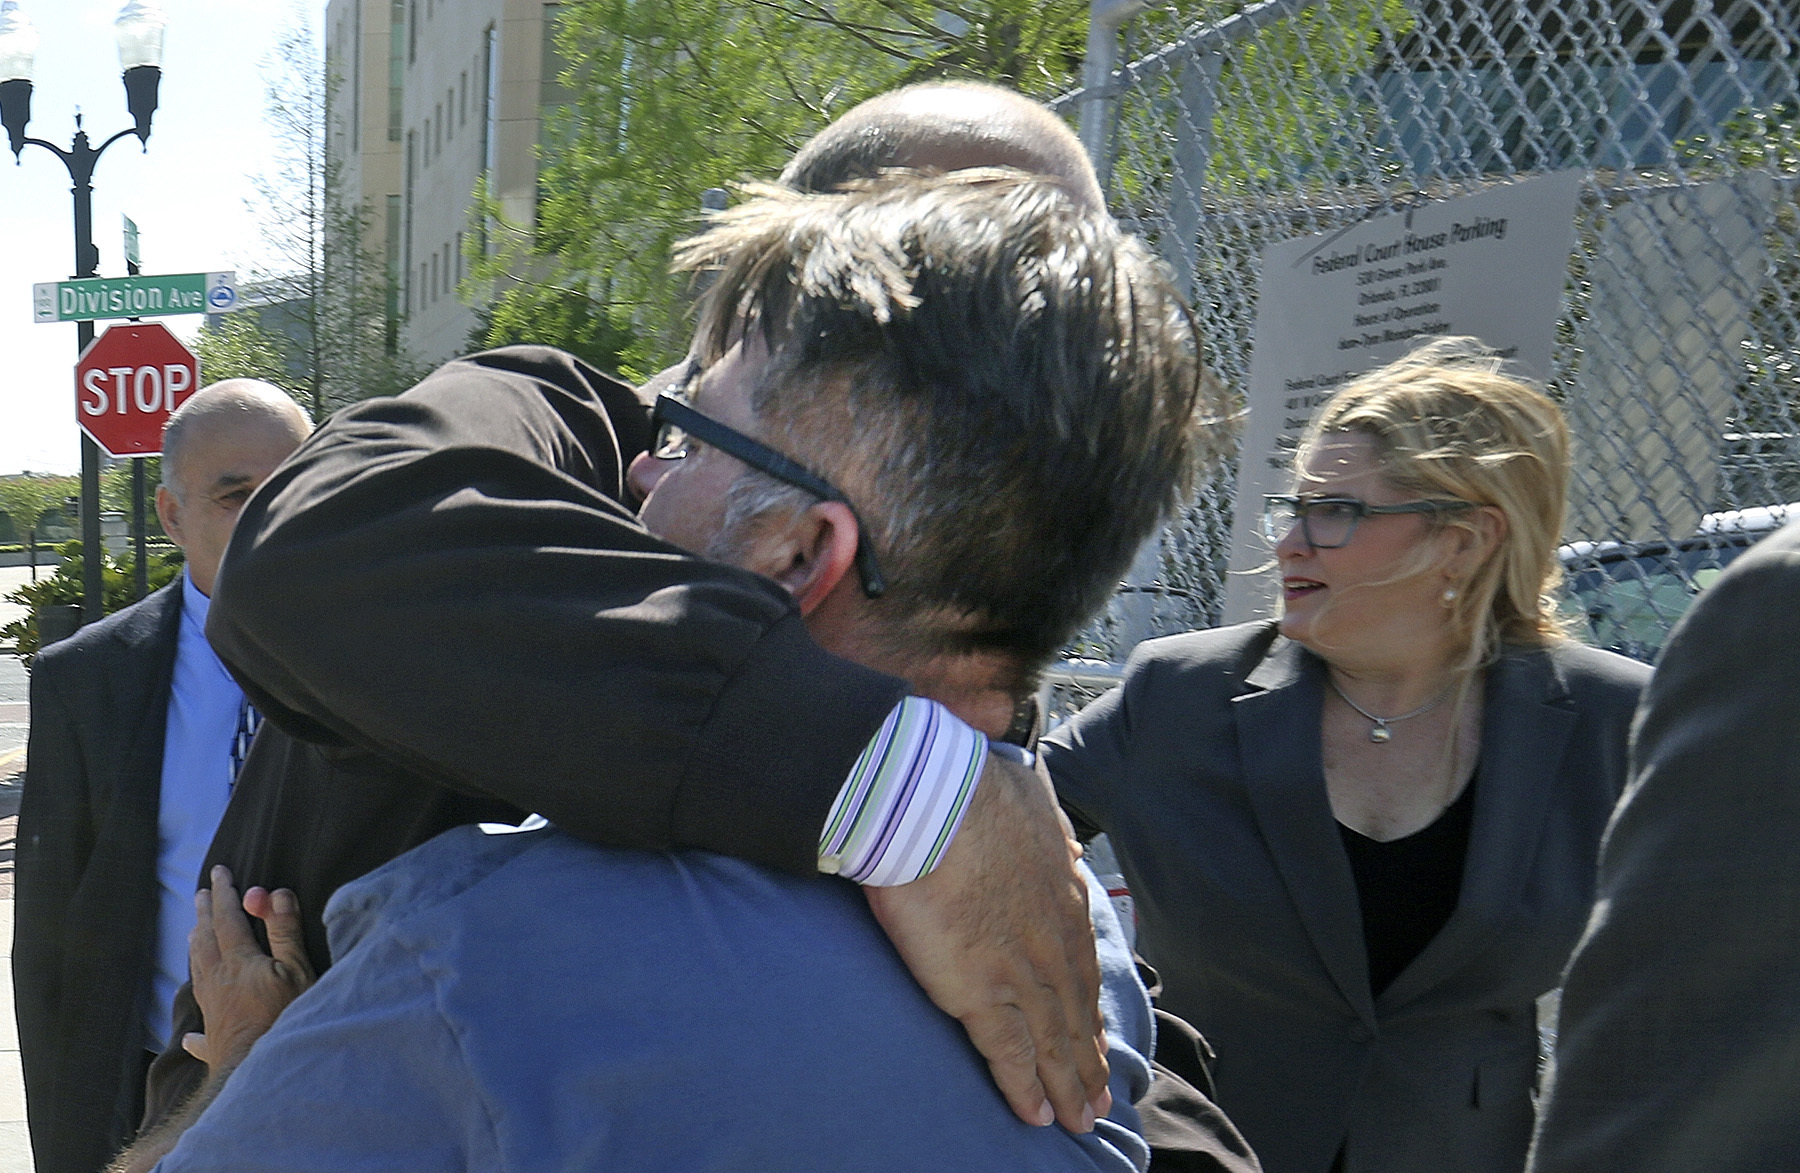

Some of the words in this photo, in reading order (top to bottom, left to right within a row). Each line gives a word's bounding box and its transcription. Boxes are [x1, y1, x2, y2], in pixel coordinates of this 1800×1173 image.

[1403, 231, 1448, 255] House
[61, 283, 163, 315] Division
[168, 287, 203, 309] Ave
[81, 363, 192, 417] STOP
